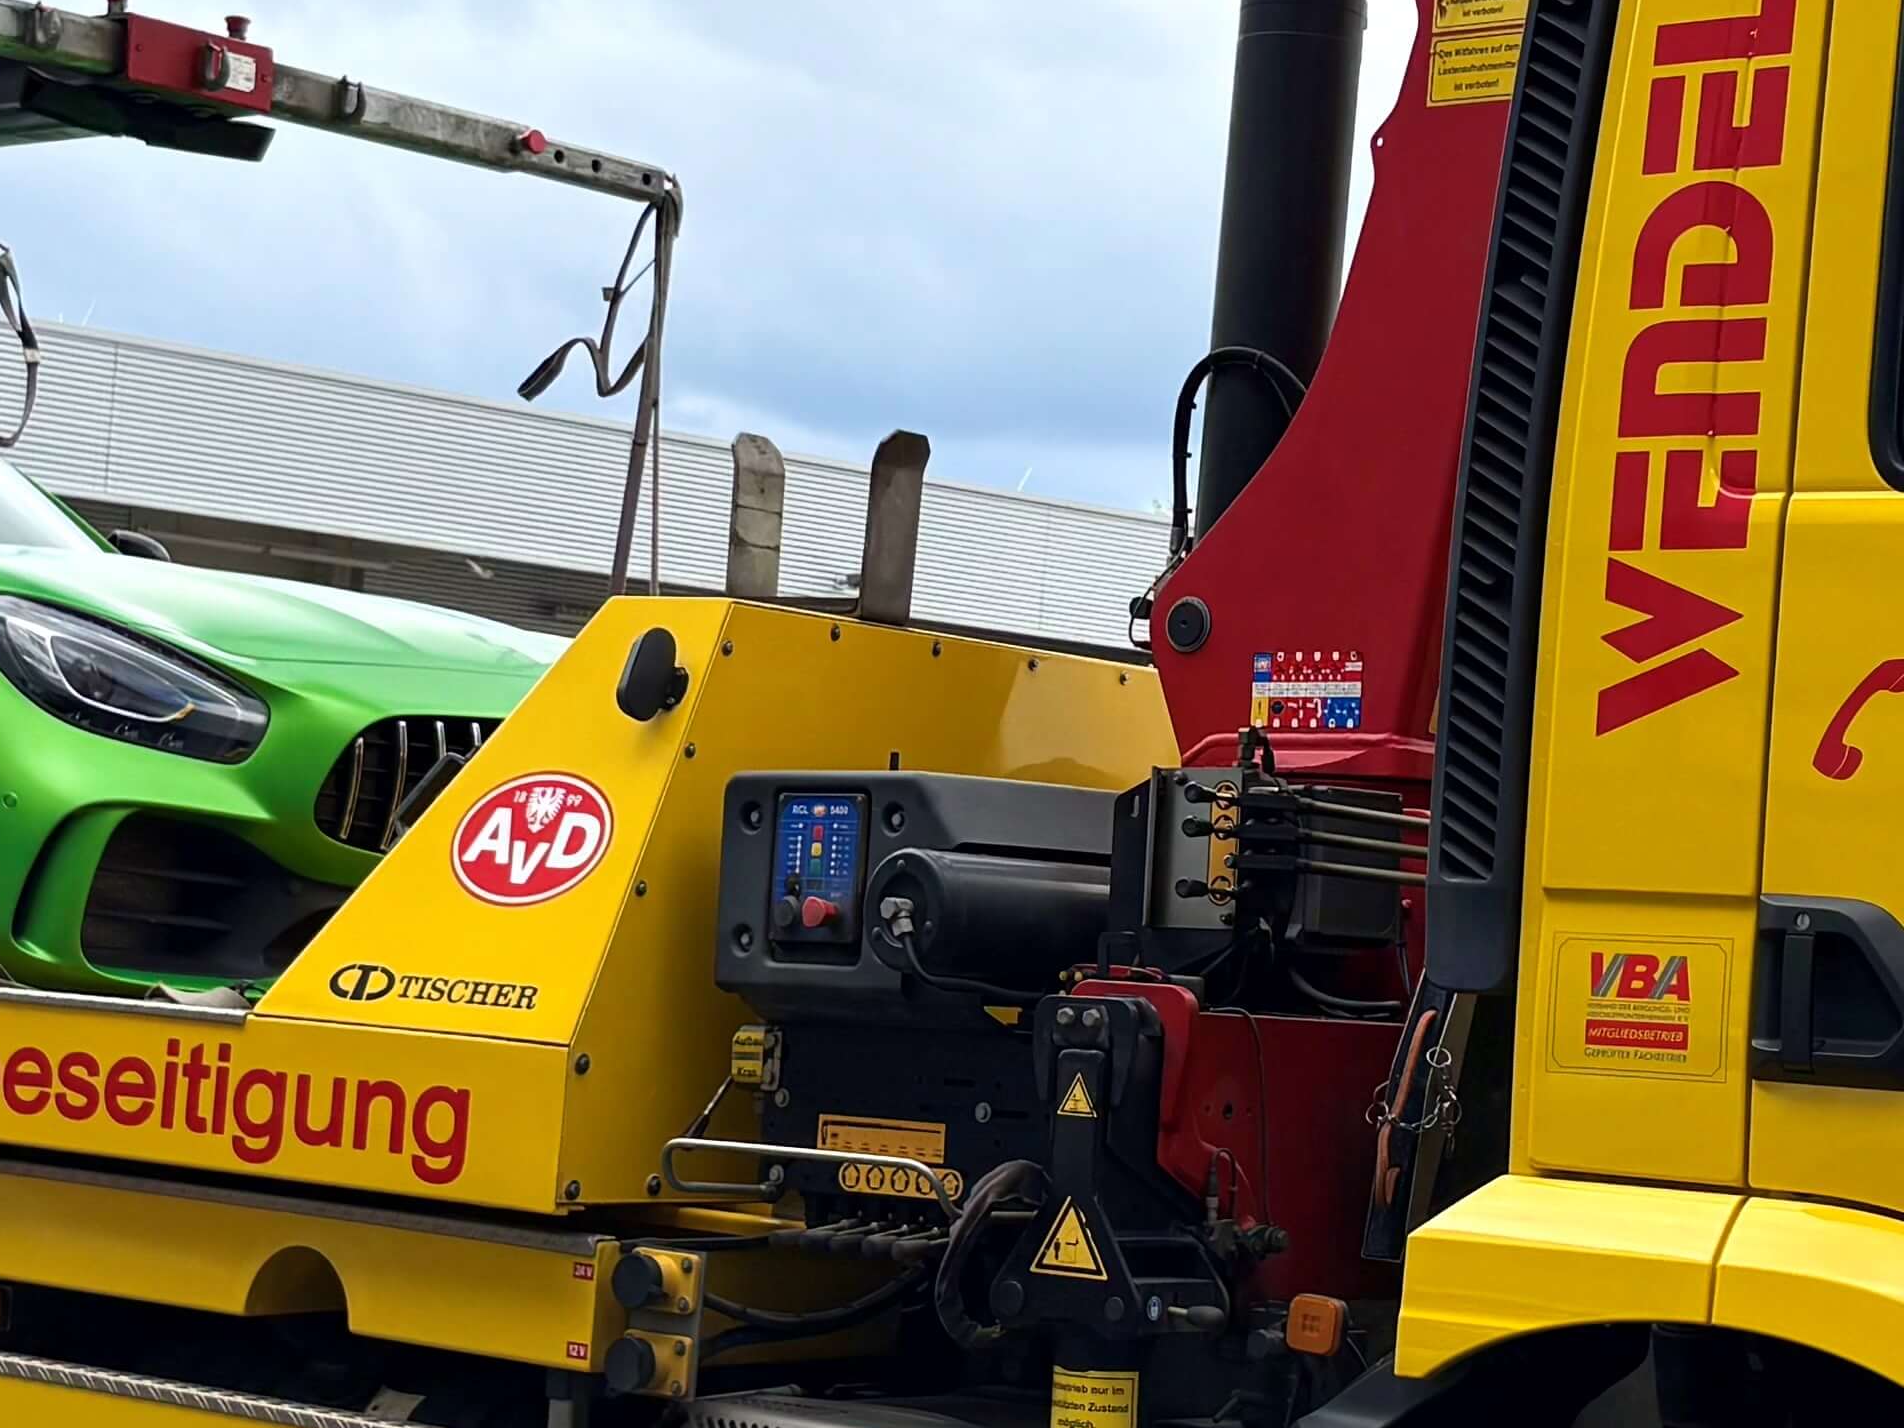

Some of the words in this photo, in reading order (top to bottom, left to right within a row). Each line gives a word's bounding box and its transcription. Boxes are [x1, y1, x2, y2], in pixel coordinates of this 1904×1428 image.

[566, 794, 584, 807] 99
[1590, 951, 1692, 1002] VBA
[397, 975, 539, 1010] TISCHER
[1587, 1026, 1684, 1042] MITGLIEDSBETRIEB
